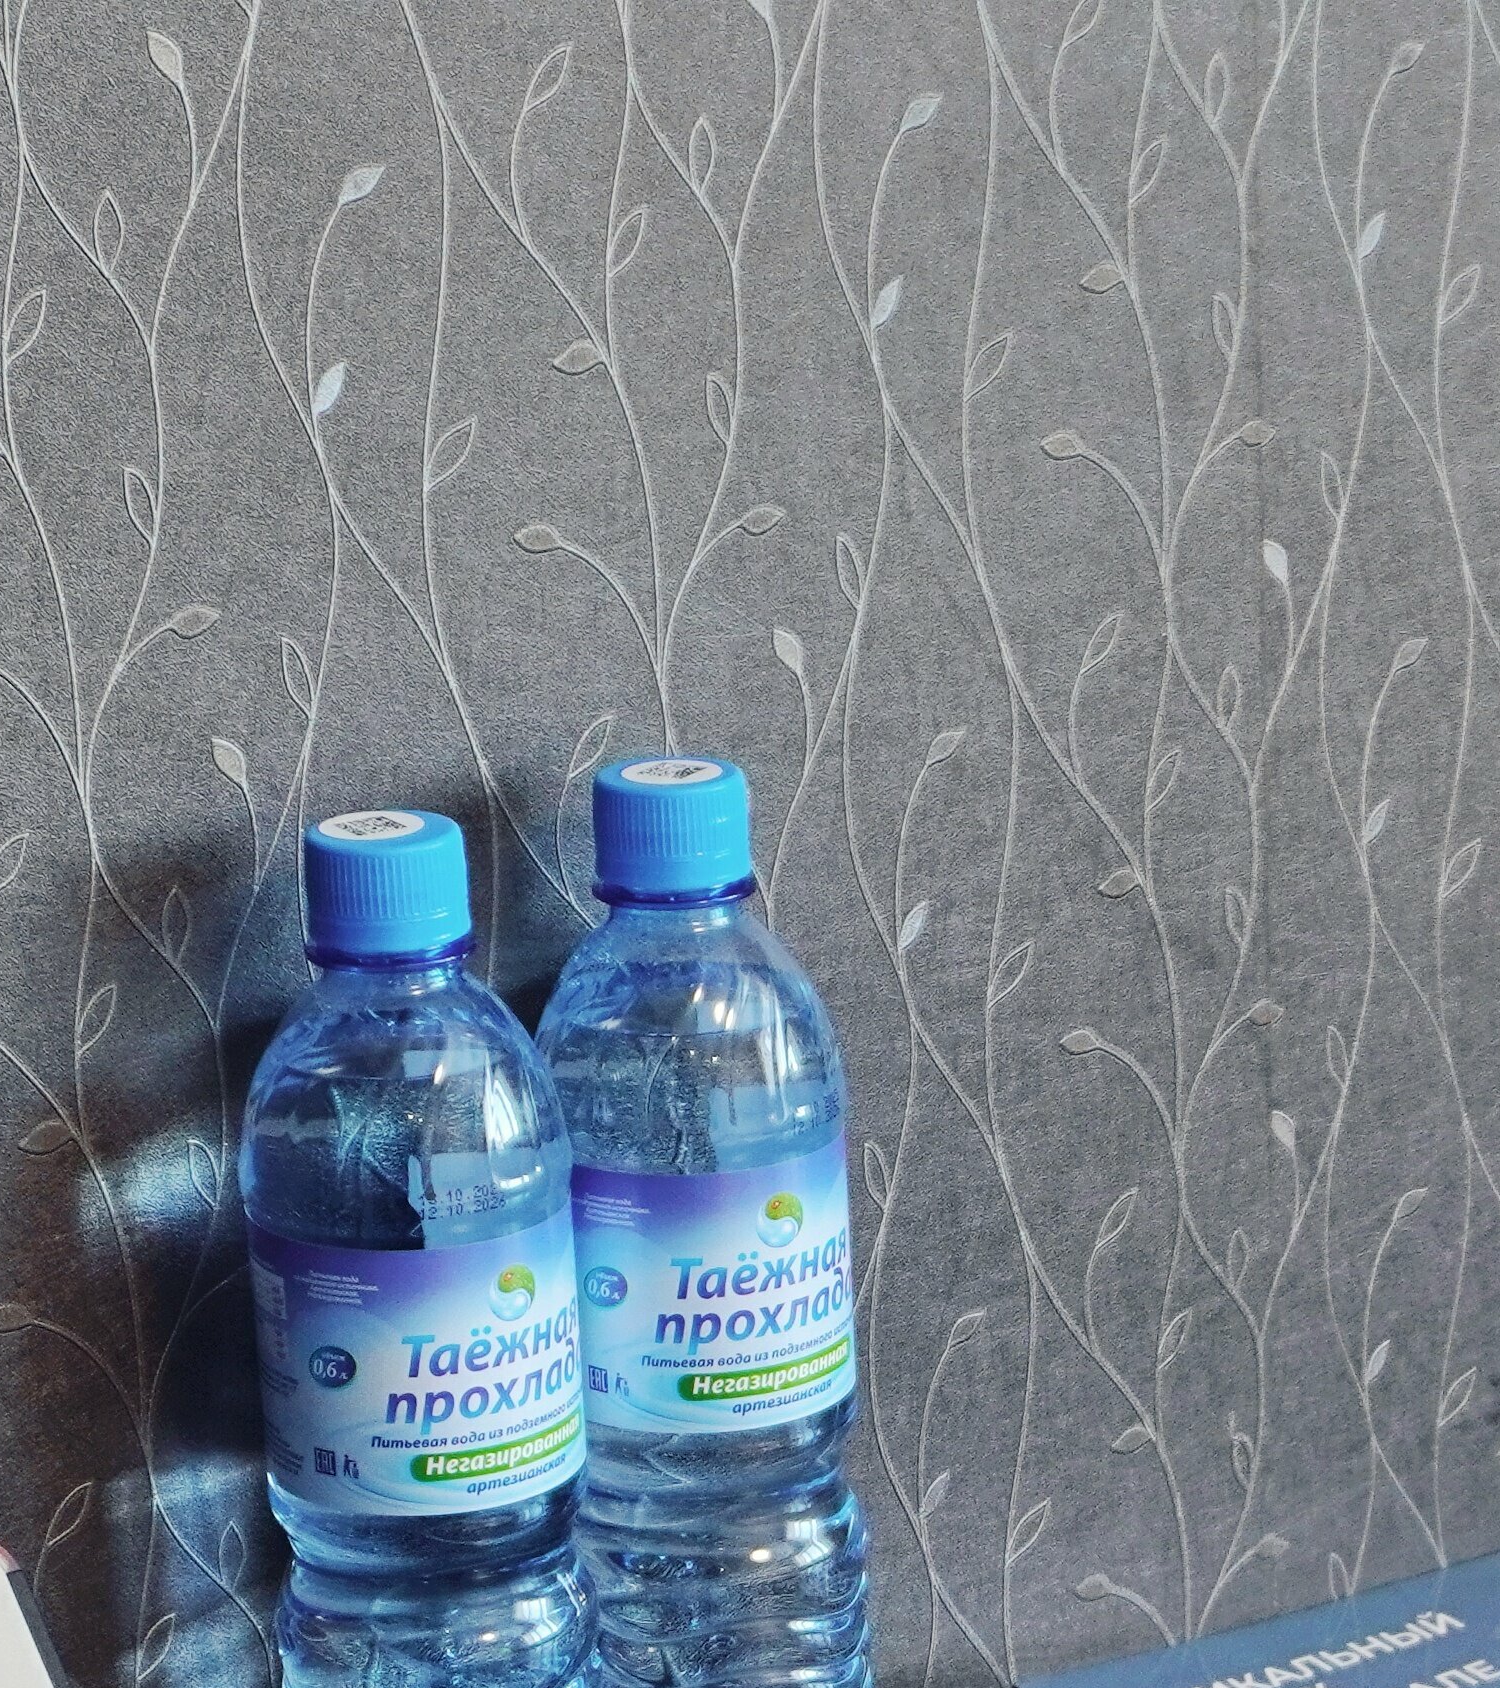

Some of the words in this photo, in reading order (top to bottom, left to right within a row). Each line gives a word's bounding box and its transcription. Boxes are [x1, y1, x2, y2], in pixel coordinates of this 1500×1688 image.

[670, 1227, 846, 1299] Таёжная
[401, 1295, 578, 1378] Таёжная
[641, 1355, 713, 1369] Питьевая
[717, 1355, 751, 1367] вода
[755, 1352, 768, 1362] из
[772, 1329, 832, 1359] подземного
[313, 1359, 337, 1379] 0,6
[732, 1380, 832, 1416] артезианская
[371, 1436, 447, 1449] Питьевая
[451, 1431, 485, 1446] вода
[489, 1429, 503, 1440] из
[507, 1403, 565, 1436] подземного
[467, 1453, 565, 1496] артезианская
